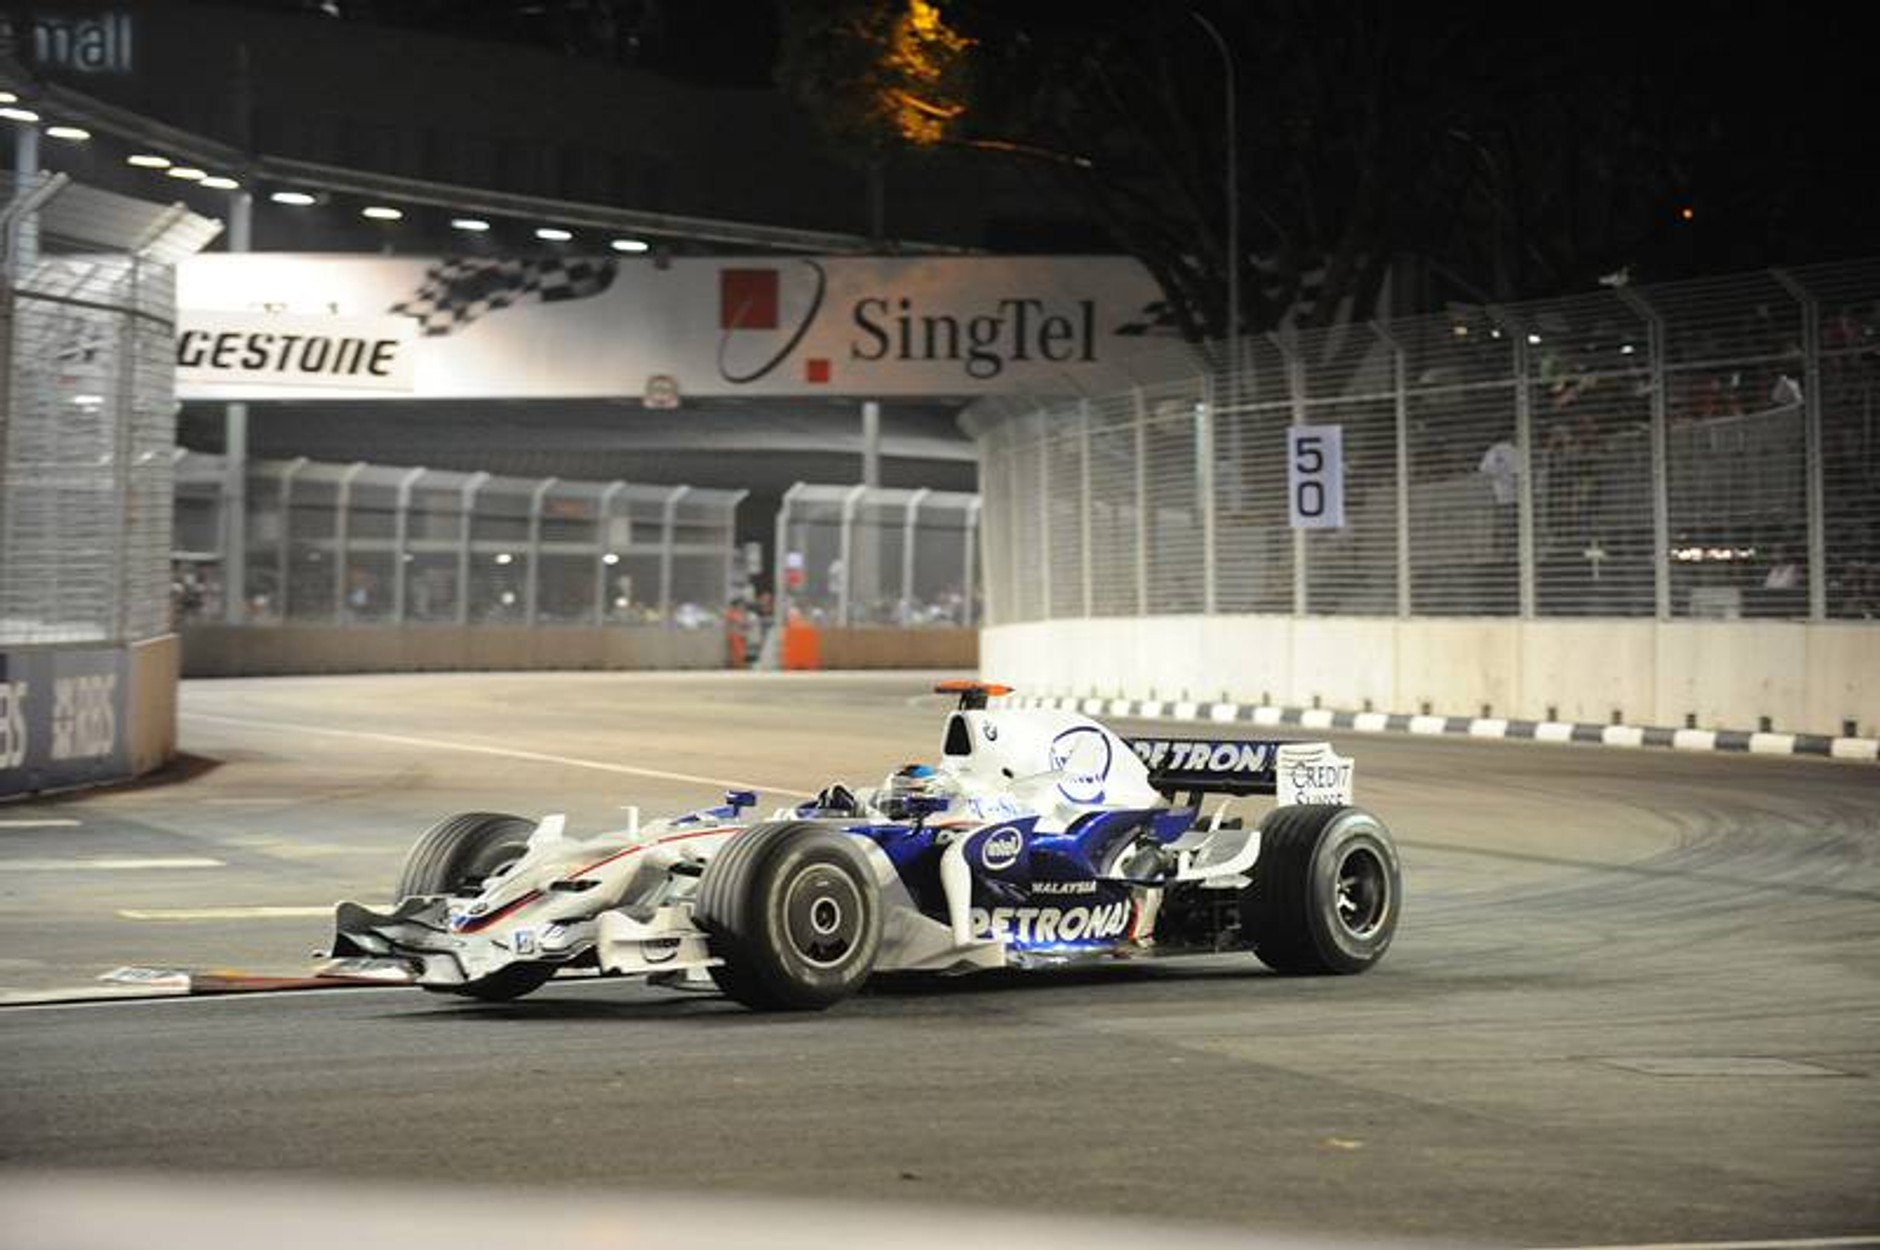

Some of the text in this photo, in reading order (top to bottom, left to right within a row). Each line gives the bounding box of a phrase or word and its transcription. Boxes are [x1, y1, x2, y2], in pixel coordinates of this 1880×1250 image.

[177, 330, 399, 376] GESTONE
[851, 297, 1098, 379] SingTel
[1032, 881, 1097, 894] MALAYSIA
